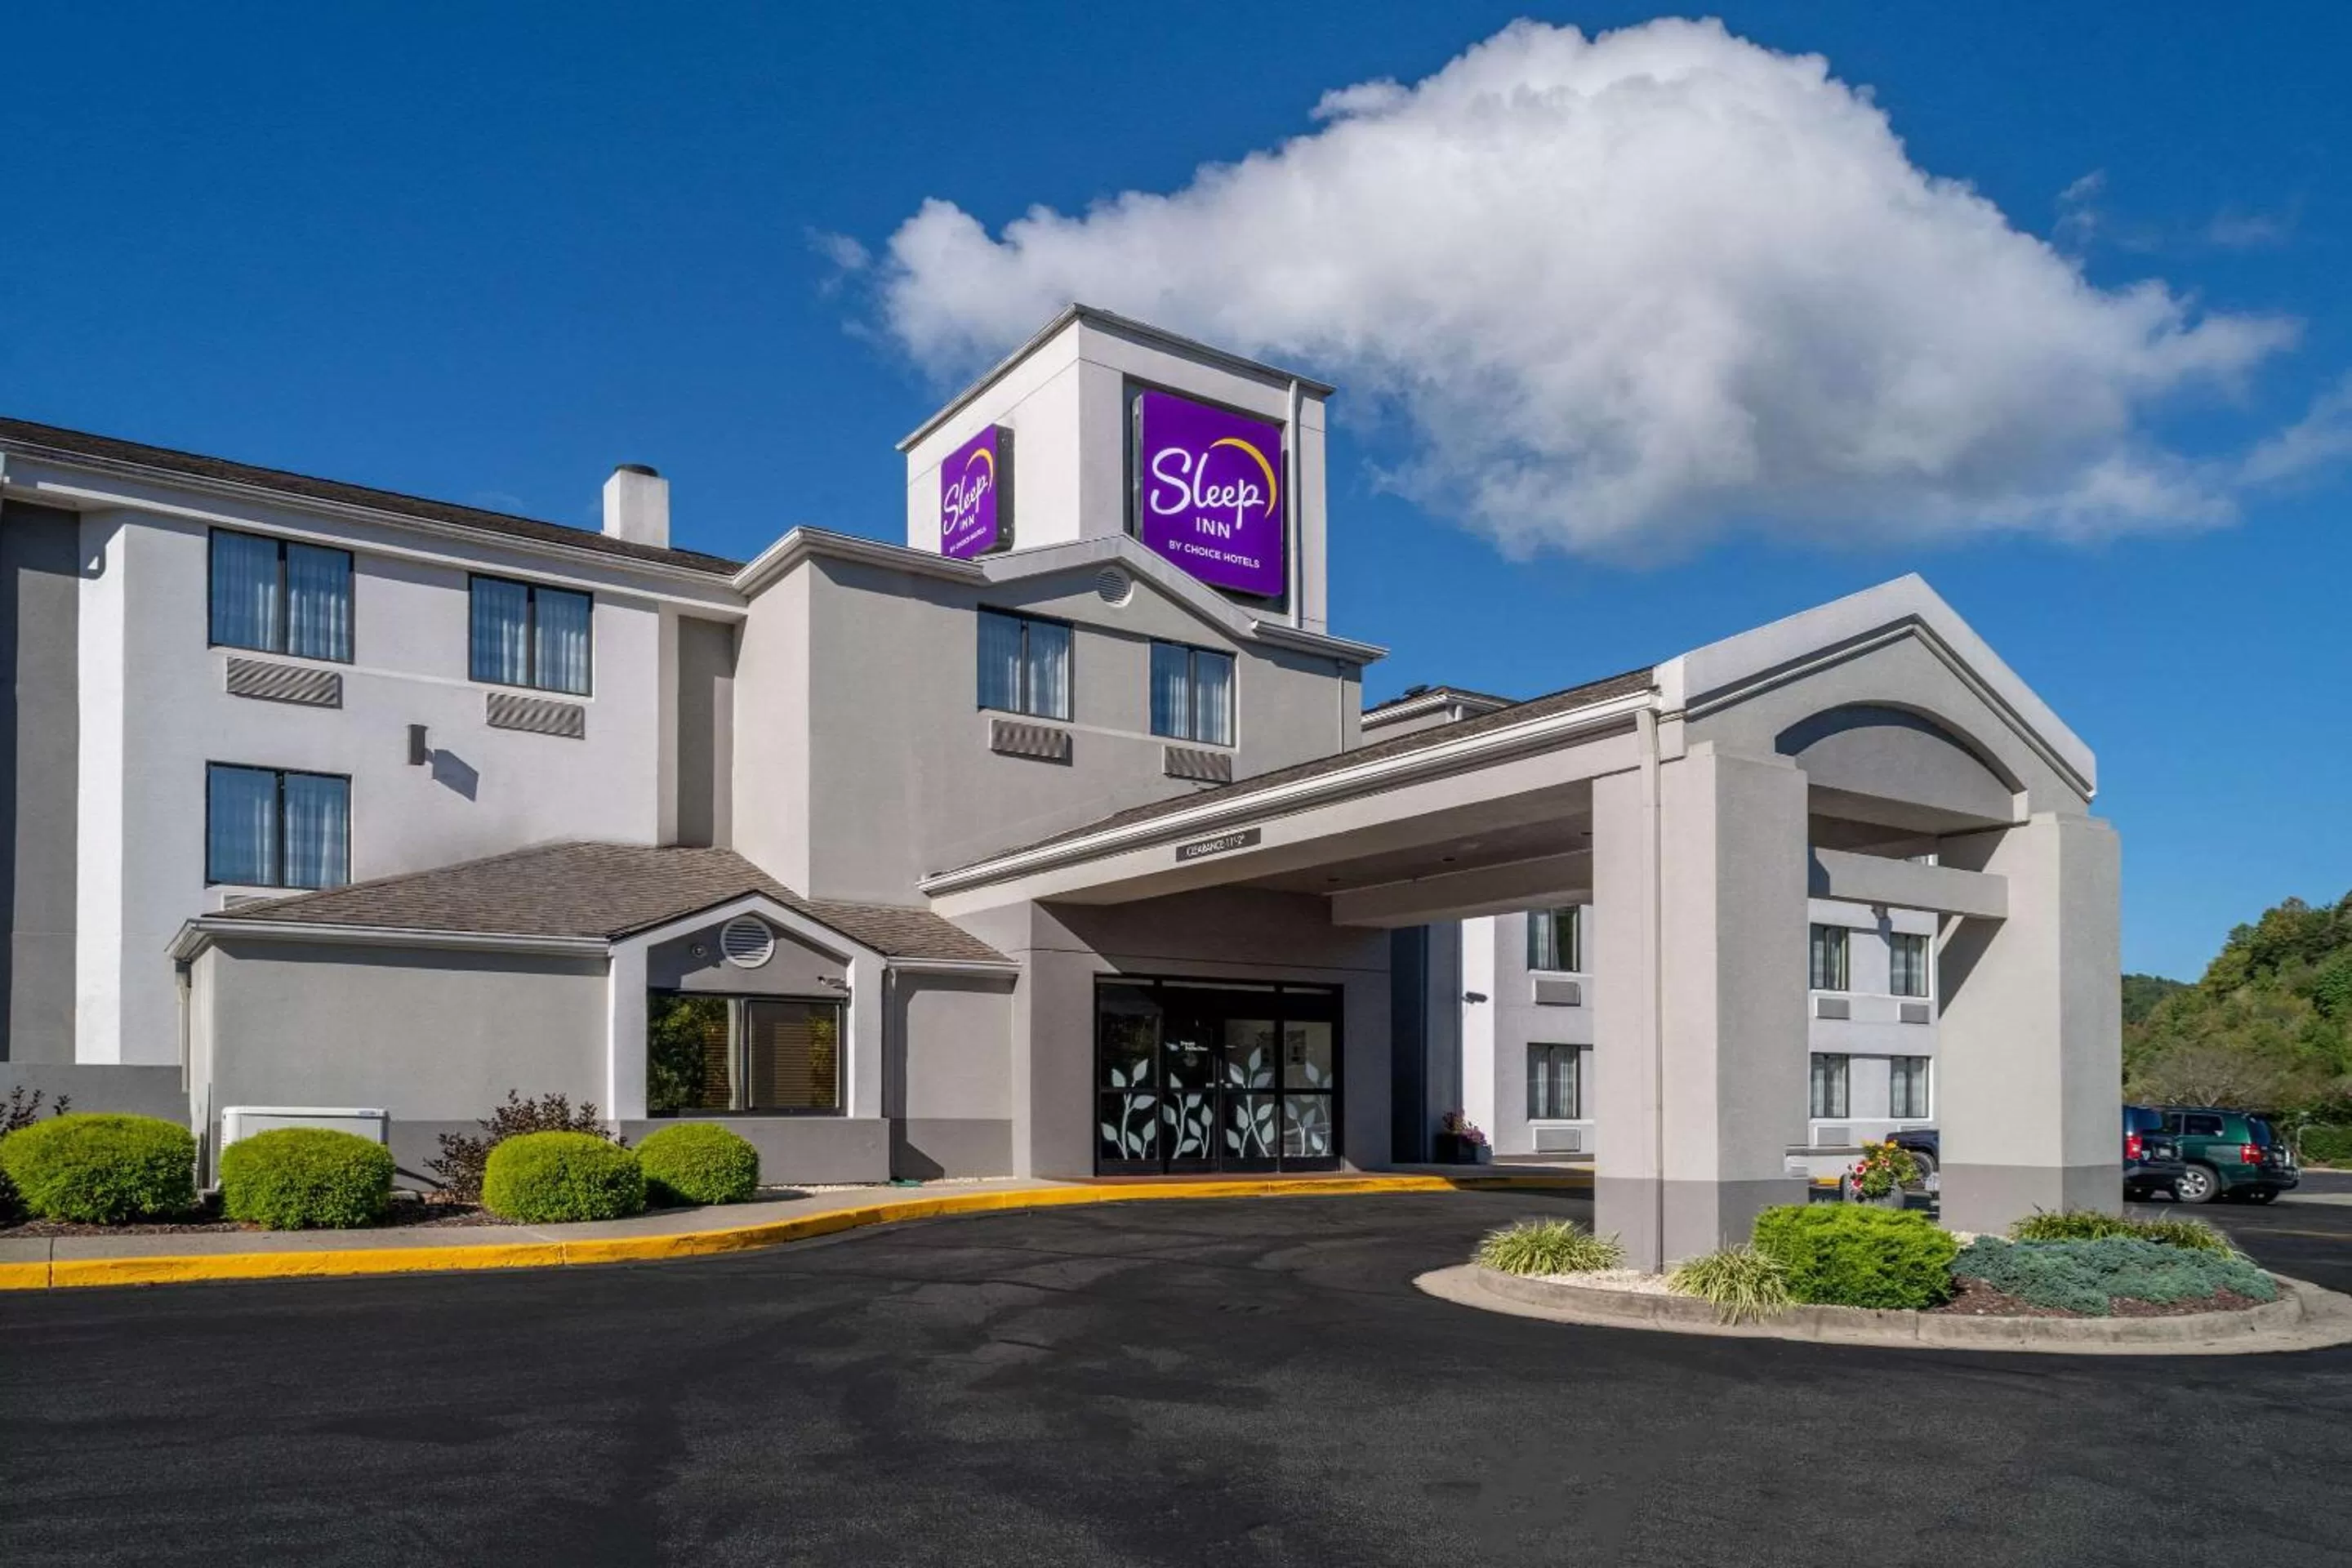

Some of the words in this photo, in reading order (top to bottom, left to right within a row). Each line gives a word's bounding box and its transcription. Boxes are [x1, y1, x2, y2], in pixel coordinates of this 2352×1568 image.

[943, 474, 989, 536] Sleep
[1150, 447, 1265, 530] Sleep
[1196, 516, 1231, 539] INN
[1169, 540, 1182, 551] BY
[1184, 543, 1222, 561] CHOICE
[1223, 552, 1260, 569] HOTELS
